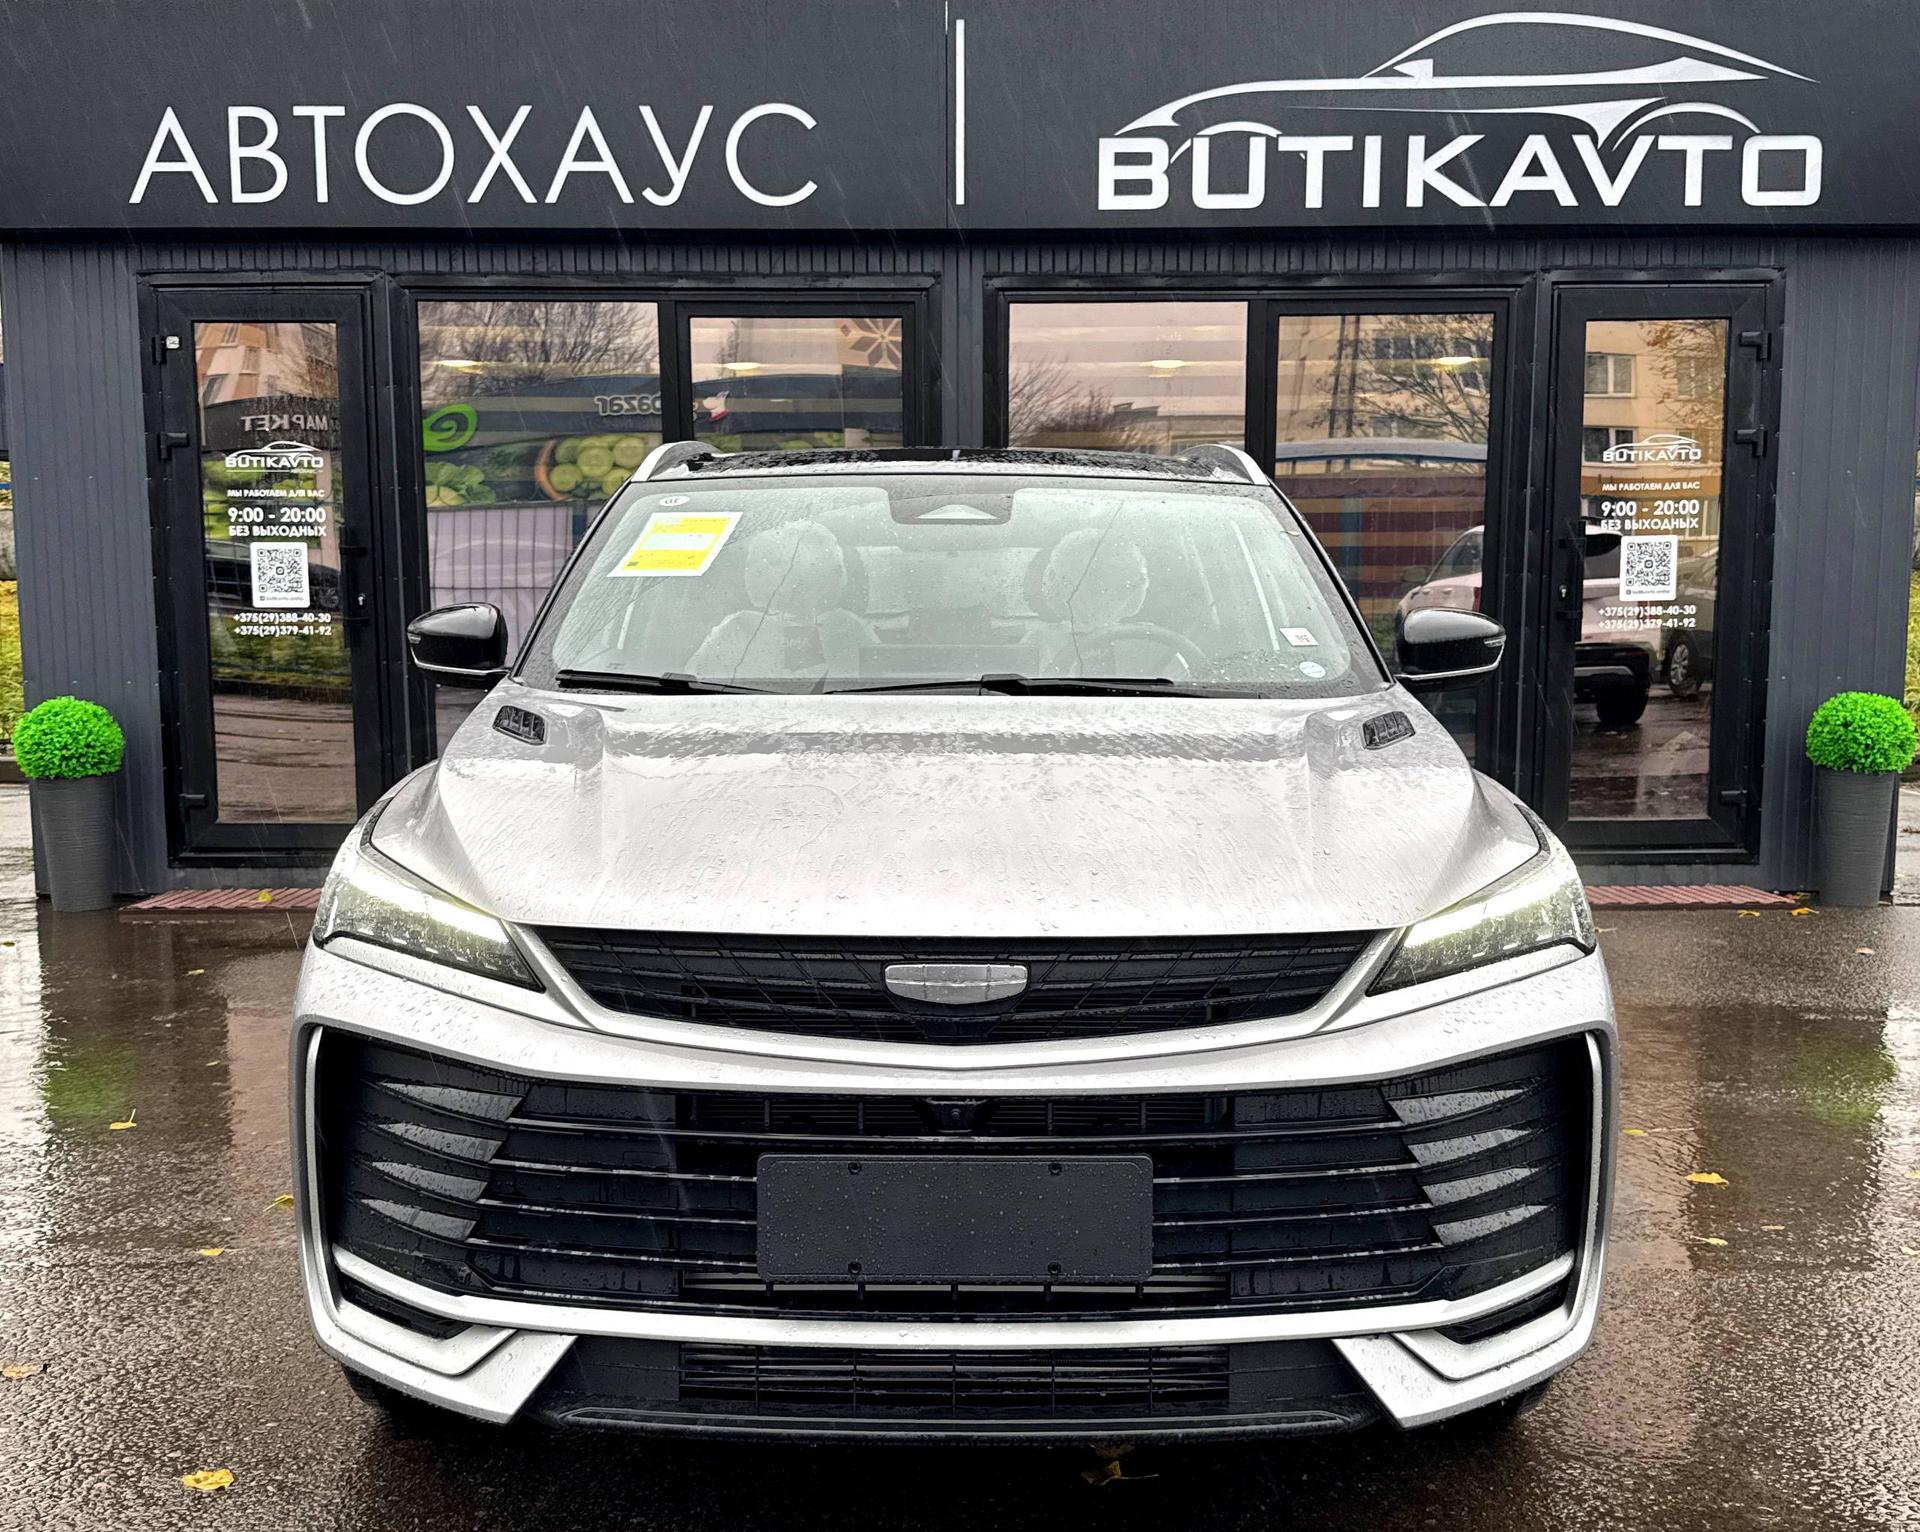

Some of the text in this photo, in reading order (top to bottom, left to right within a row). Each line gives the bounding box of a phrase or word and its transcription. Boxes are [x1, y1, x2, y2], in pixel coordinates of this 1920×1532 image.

[129, 102, 818, 207] АВТОХАУС
[1097, 134, 1823, 210] BUTIKAVTO
[225, 456, 324, 468] BUTIKAVTO
[1602, 449, 1702, 462] BUTIKAVTO
[1619, 483, 1662, 491] РАБОТАЕМ
[1663, 482, 1681, 490] ДЛЯ
[1683, 481, 1700, 490] ВАС
[228, 507, 264, 523] 9:00
[280, 507, 326, 523] 20:00
[1601, 501, 1637, 517] 9:00
[1653, 500, 1700, 515] 20:00
[229, 524, 327, 538] БЕЗ ВЫХОДНЫХ
[1600, 518, 1699, 531] БЕЗ ВЫХОДНЫХ
[1598, 605, 1697, 618] +375(29)388-40-30
[233, 613, 331, 624] +375(29)388-40-30
[1598, 618, 1697, 630] +375(29)379-41-92
[234, 625, 332, 637] +375(29)379-41-92
